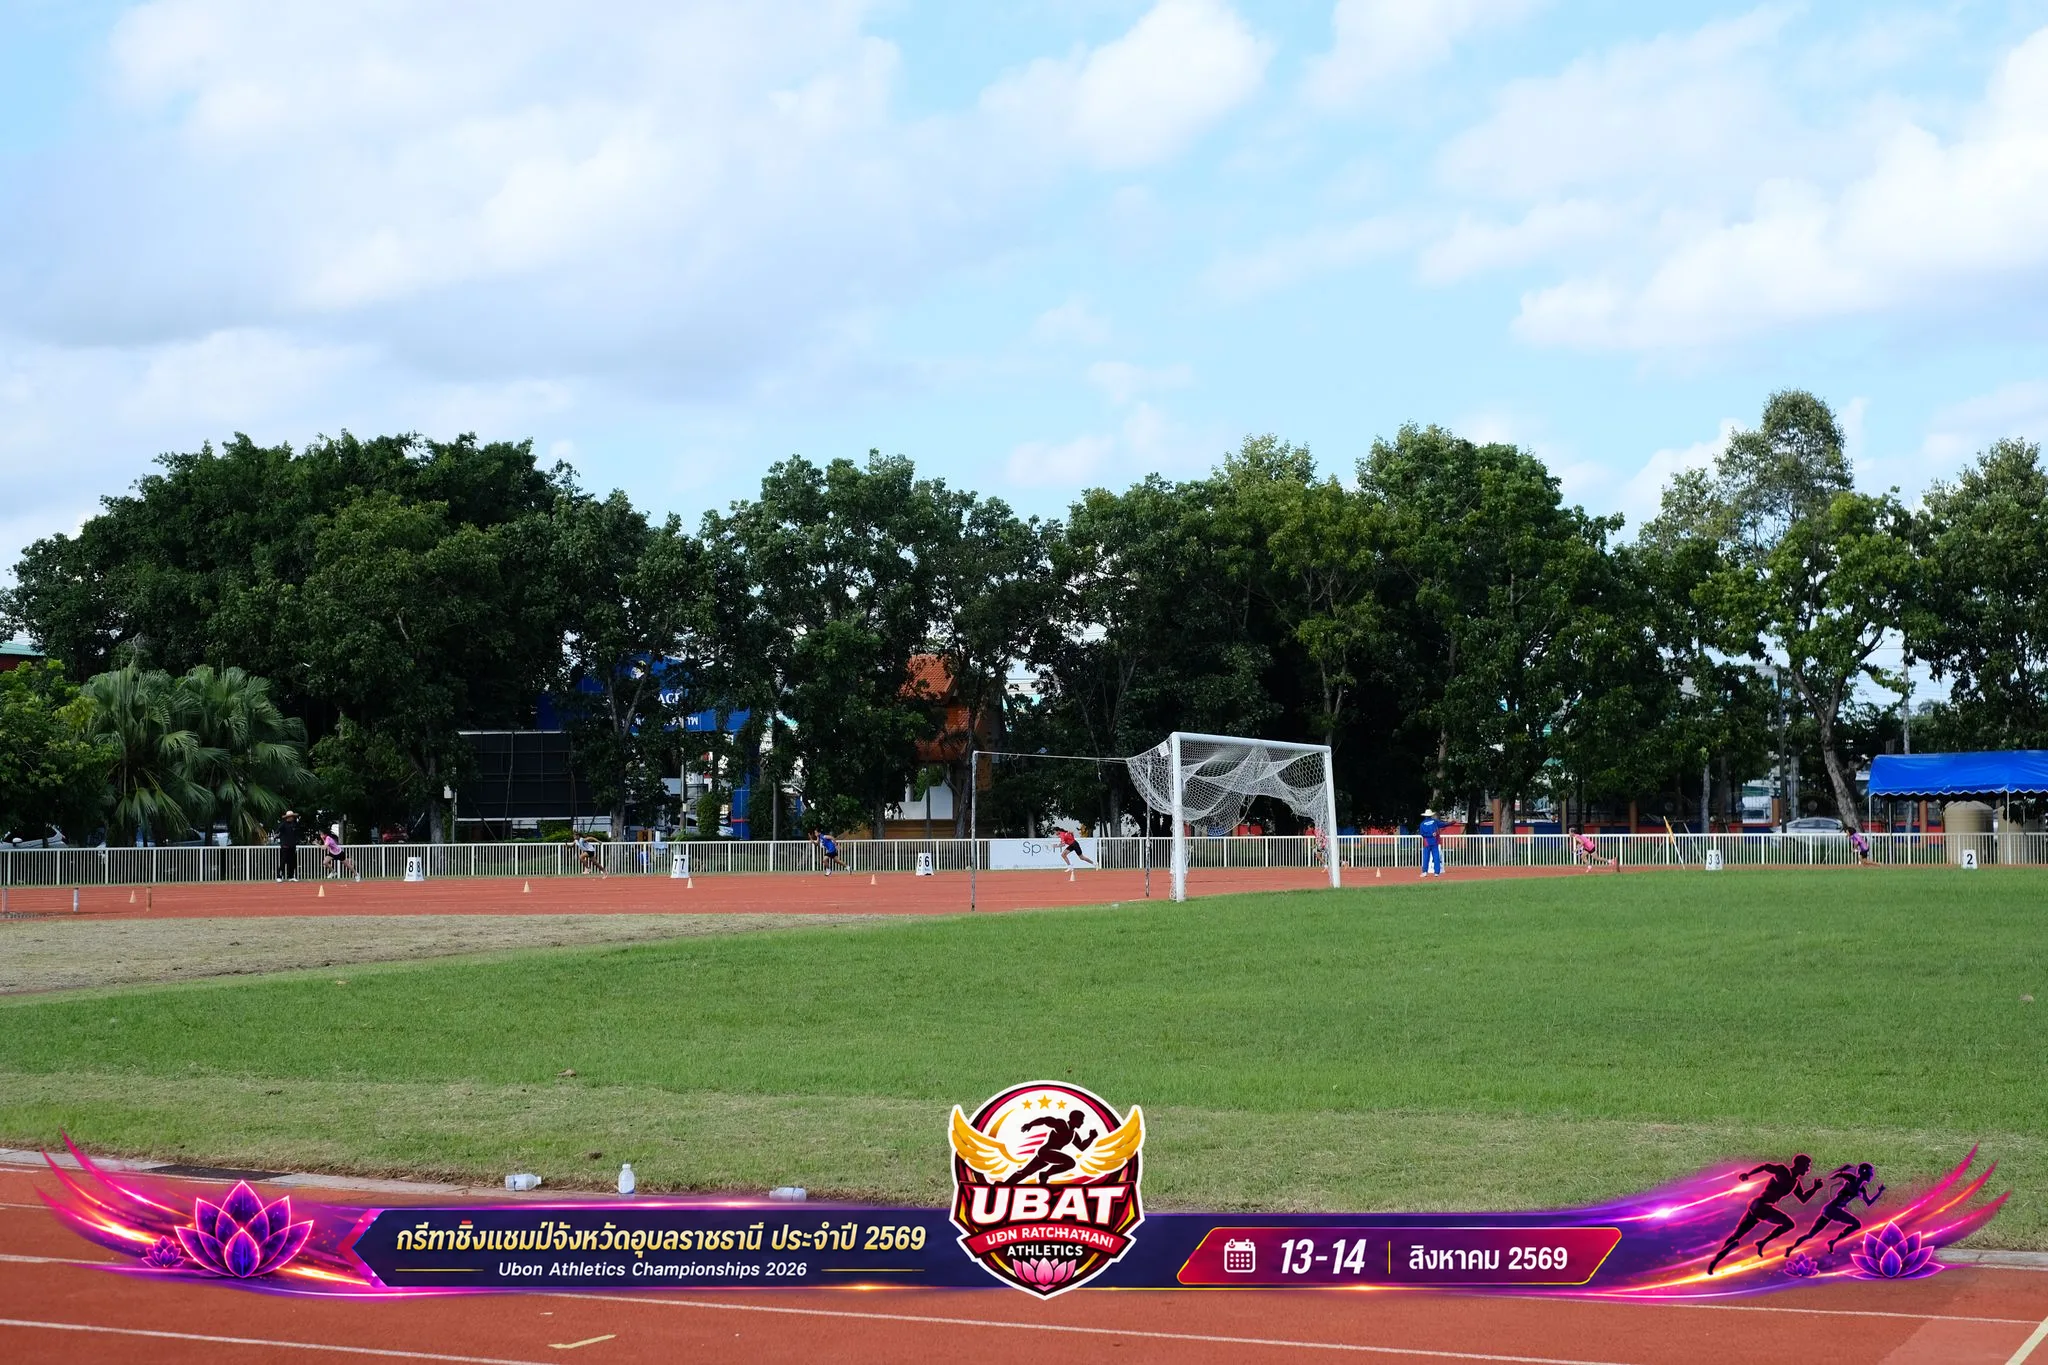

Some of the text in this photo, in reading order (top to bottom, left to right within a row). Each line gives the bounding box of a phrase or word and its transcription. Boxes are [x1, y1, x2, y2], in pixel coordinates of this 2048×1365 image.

[674, 858, 679, 871] 7
[680, 857, 686, 871] 7
[924, 855, 930, 867] 6
[1708, 854, 1713, 866] 3
[1715, 853, 1721, 865] 3
[1966, 853, 1973, 865] 2
[408, 861, 414, 873] 8
[416, 861, 421, 873] 8
